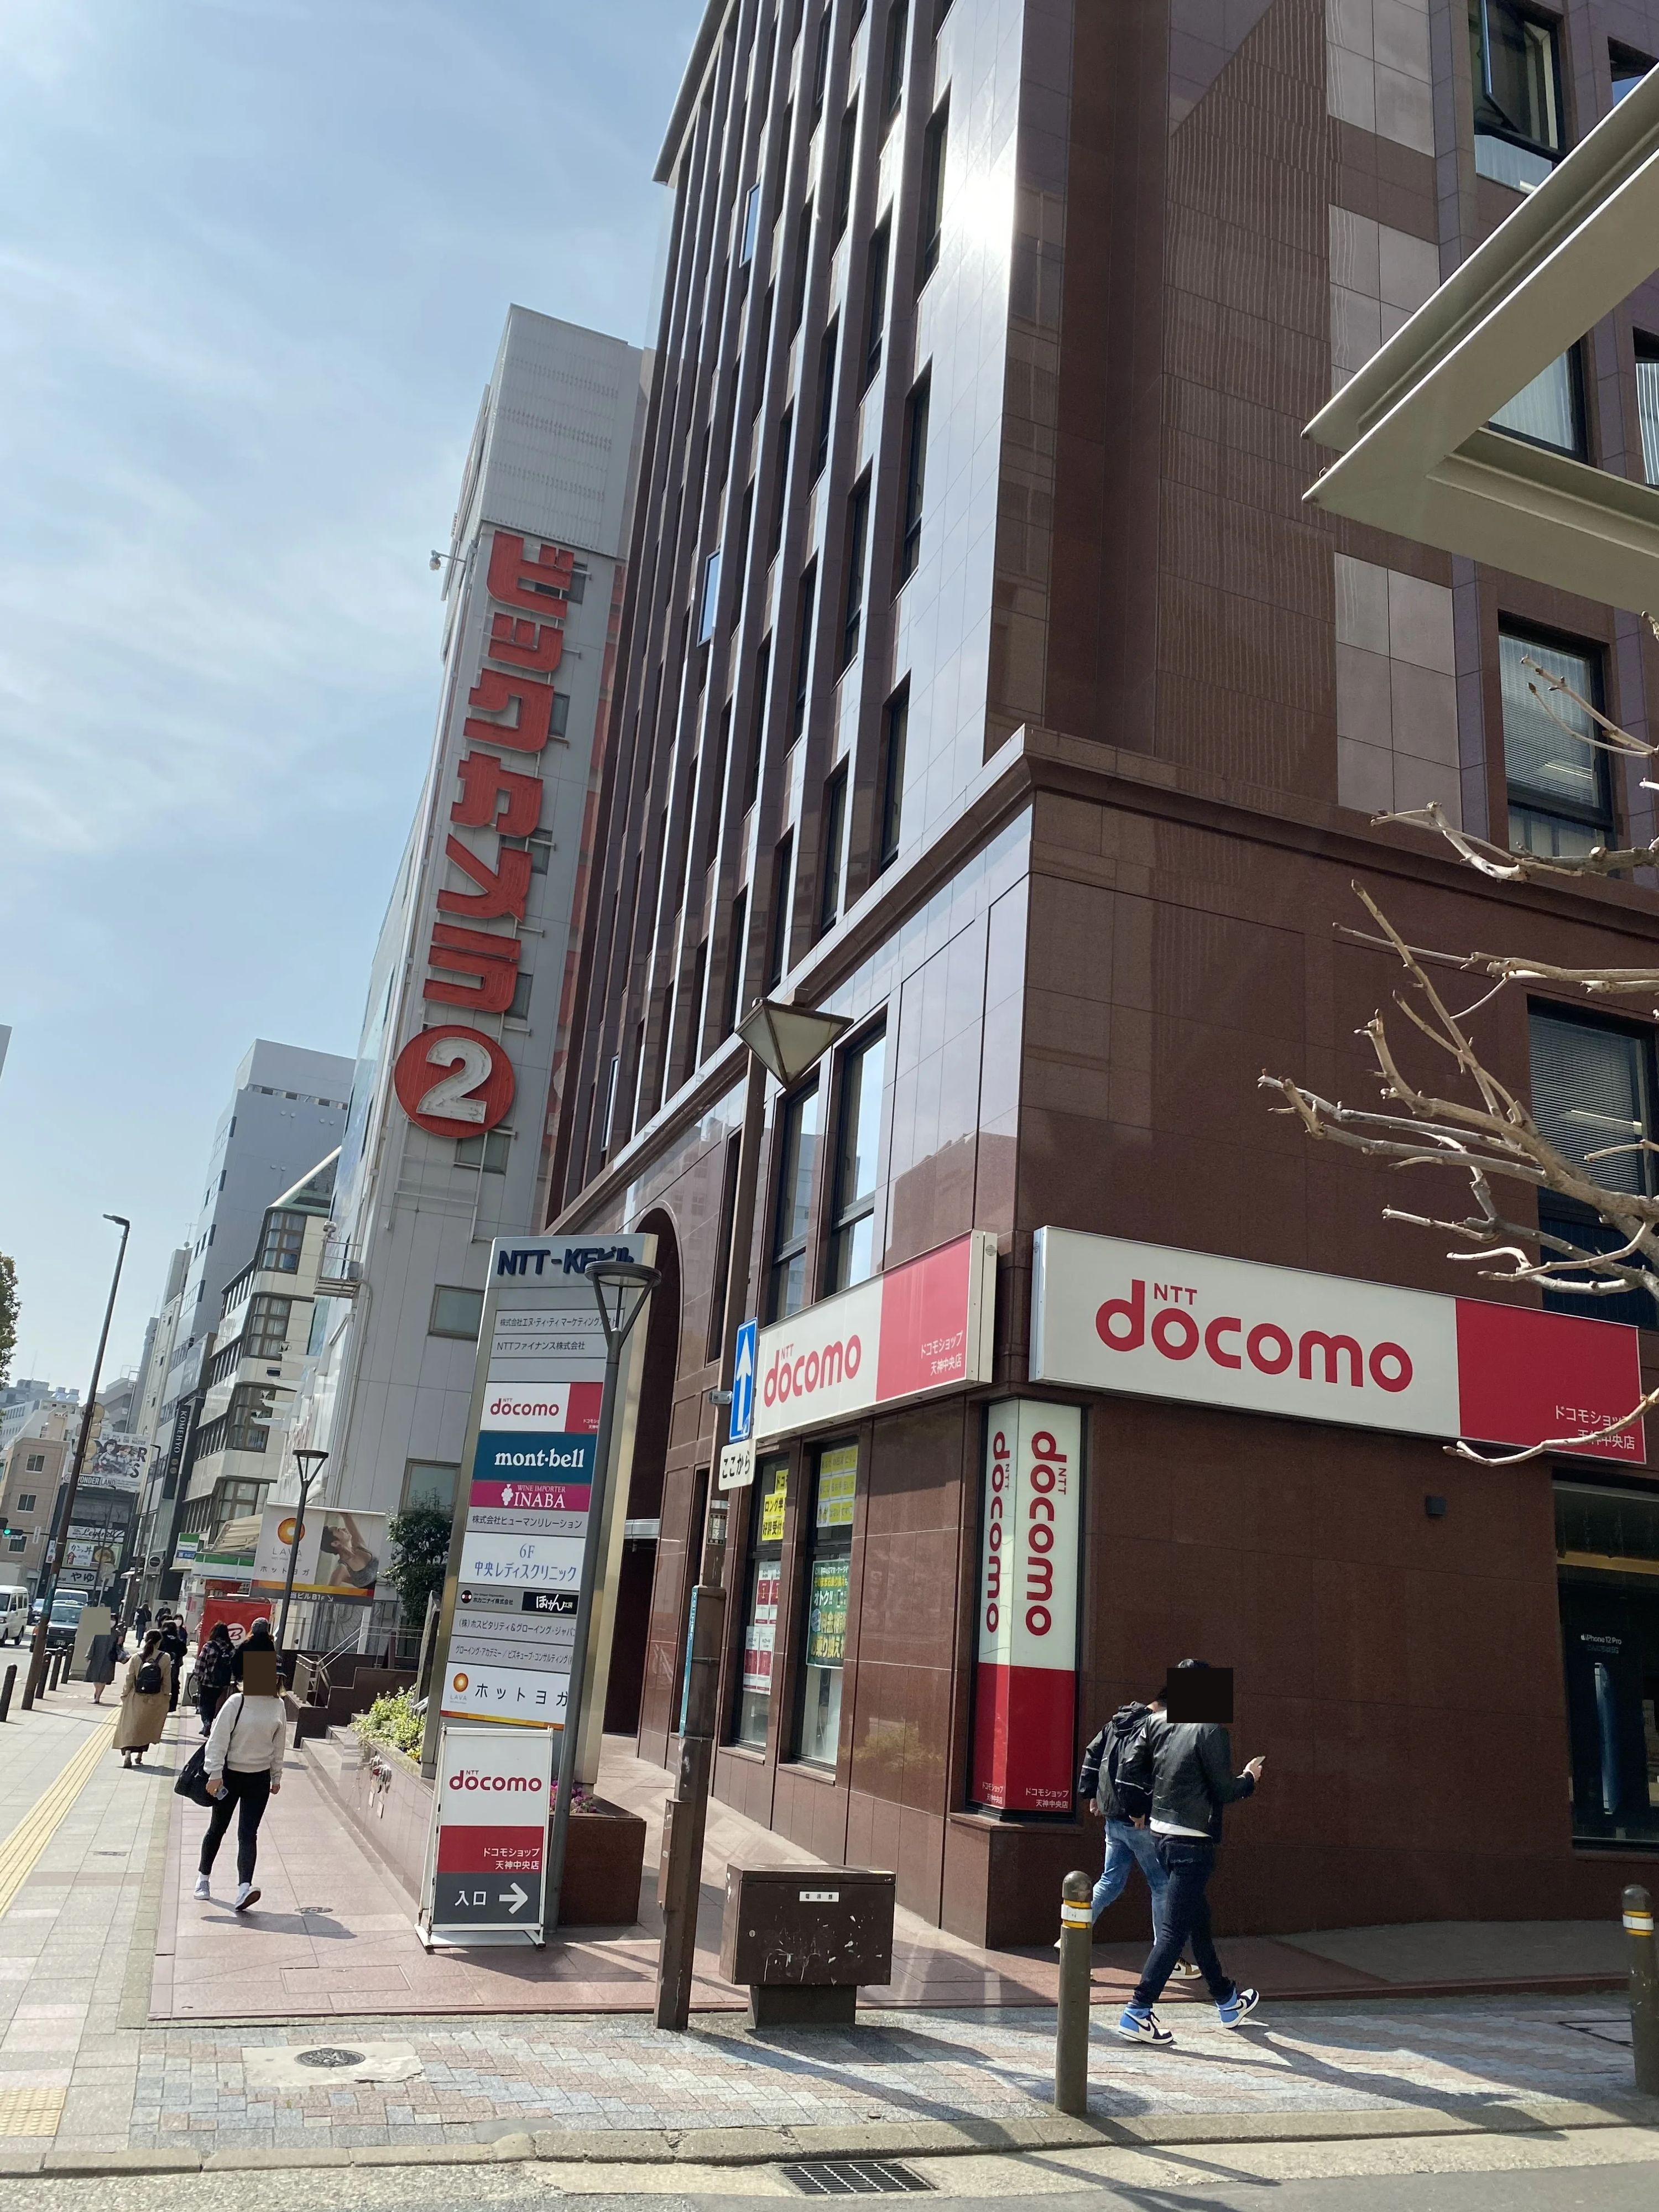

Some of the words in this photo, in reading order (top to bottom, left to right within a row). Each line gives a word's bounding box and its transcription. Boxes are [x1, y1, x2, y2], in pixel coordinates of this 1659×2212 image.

[416, 1036, 492, 1124] 2
[1154, 1283, 1197, 1305] NTT
[561, 1316, 615, 1327] マーケティングト
[497, 1341, 585, 1351] NTTファイナンス株式会社
[921, 1330, 963, 1359] ドコモショップ
[1095, 1279, 1413, 1392] docomo
[781, 1343, 794, 1360] NTT
[764, 1334, 861, 1407] docomo
[930, 1353, 962, 1376] 天神中央店
[490, 1398, 559, 1416] docomo
[1556, 1405, 1628, 1427] ドコモショッ
[174, 1411, 187, 1453] KOMEHYO
[722, 1450, 750, 1479] ここから
[1058, 1468, 1067, 1495] NTT
[514, 1492, 565, 1508] INABA
[765, 1497, 786, 1512] ロング学
[472, 1515, 582, 1529] 株式会社ヒューマンリレーション
[763, 1520, 784, 1536] 好評受付
[986, 1431, 1010, 1633] docomo
[1025, 1431, 1067, 1636] docomo
[519, 1543, 535, 1558] 6F
[474, 1561, 576, 1582] 中央レディスクリニック
[475, 1683, 568, 1707] ホットヨガ
[449, 1770, 542, 1792] docomo
[1026, 1788, 1069, 1798] ドコモショップ
[1035, 1799, 1068, 1809] 天神中央店
[484, 1848, 540, 1858] ドコモショップ
[495, 1860, 540, 1870] 天神中央店
[455, 1890, 487, 1906] 入口
